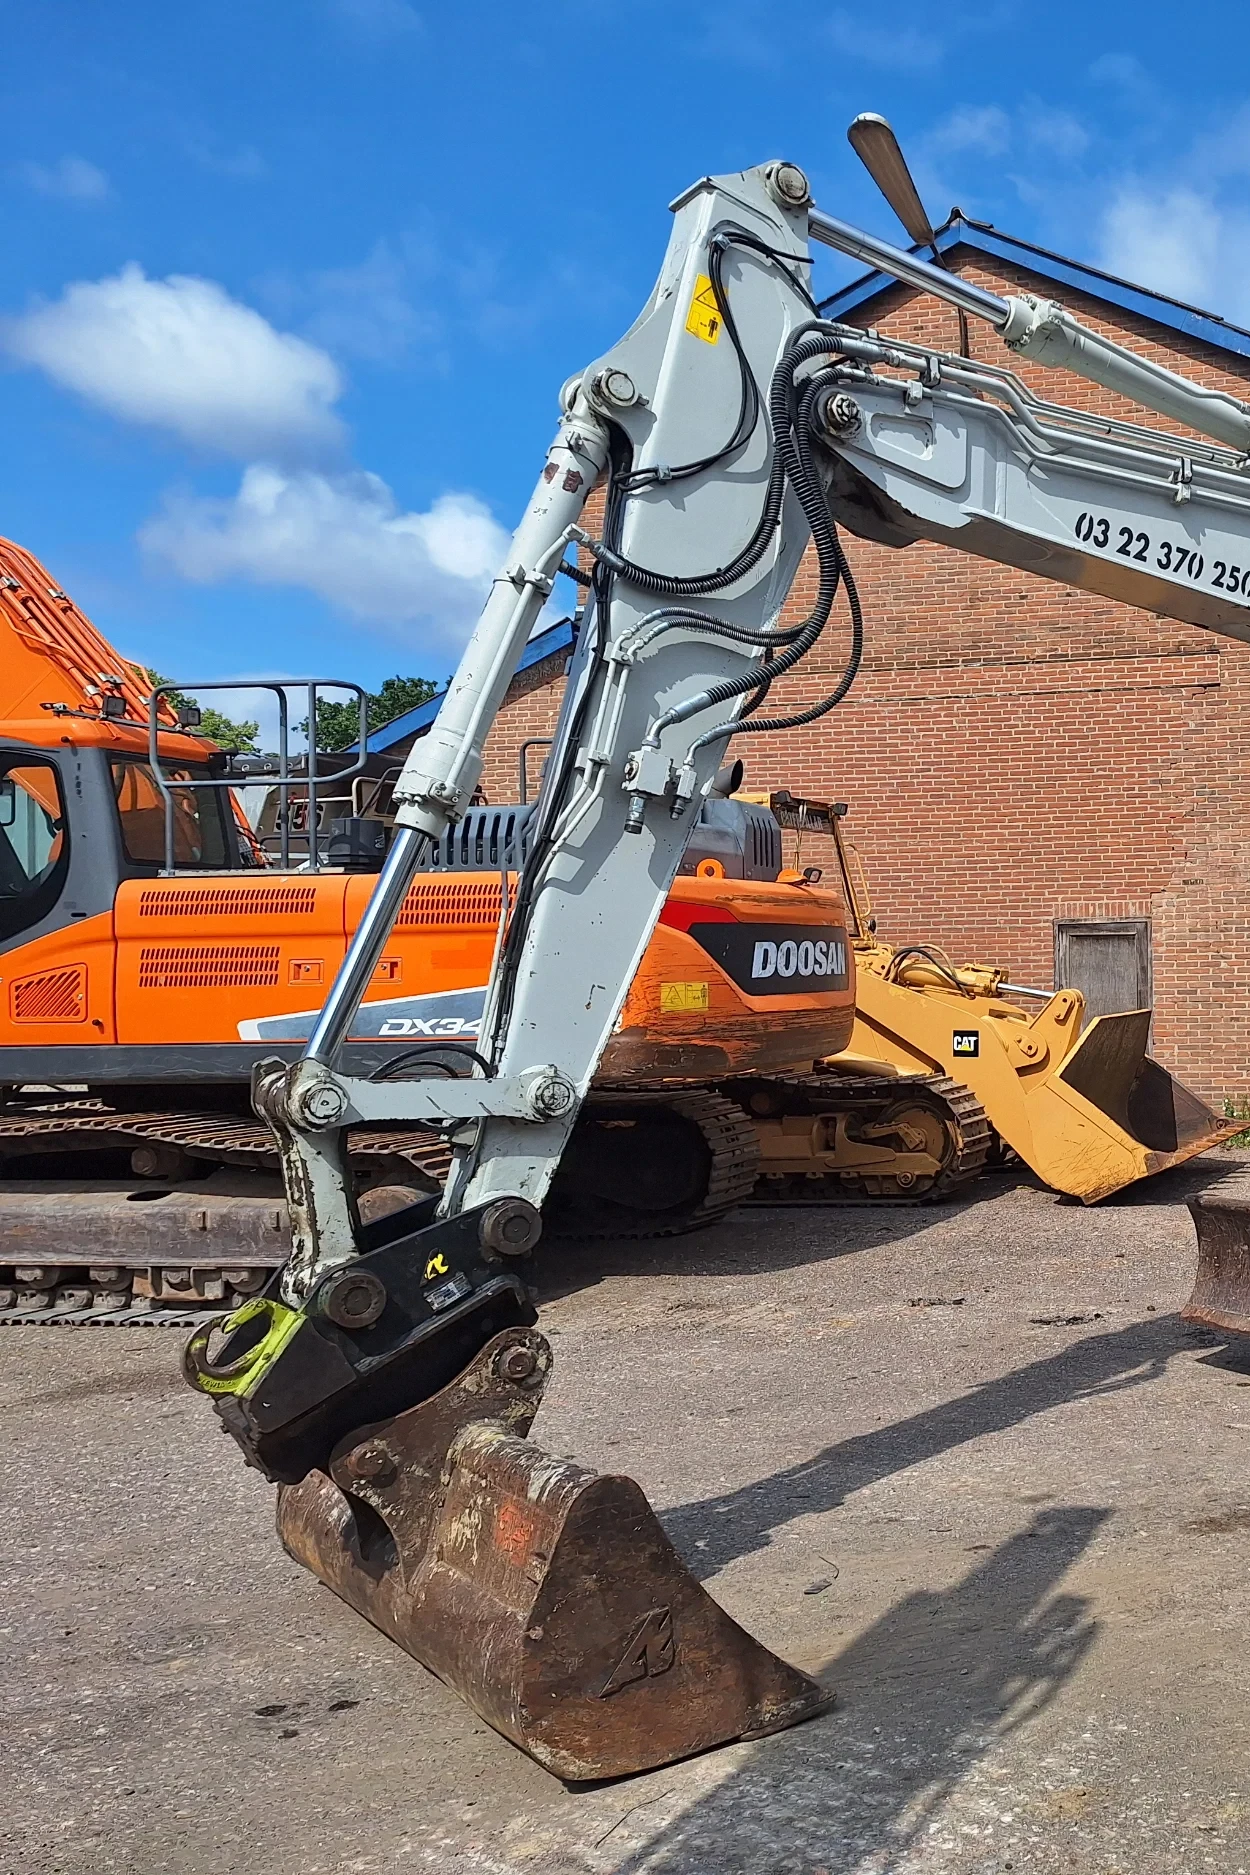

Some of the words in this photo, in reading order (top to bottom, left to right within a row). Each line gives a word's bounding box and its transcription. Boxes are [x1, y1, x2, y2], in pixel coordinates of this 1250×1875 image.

[1075, 512, 1110, 548] 03
[1116, 527, 1150, 562] 22
[1156, 541, 1204, 580] 370
[751, 940, 846, 979] DOOSAN
[953, 1036, 978, 1052] CAT
